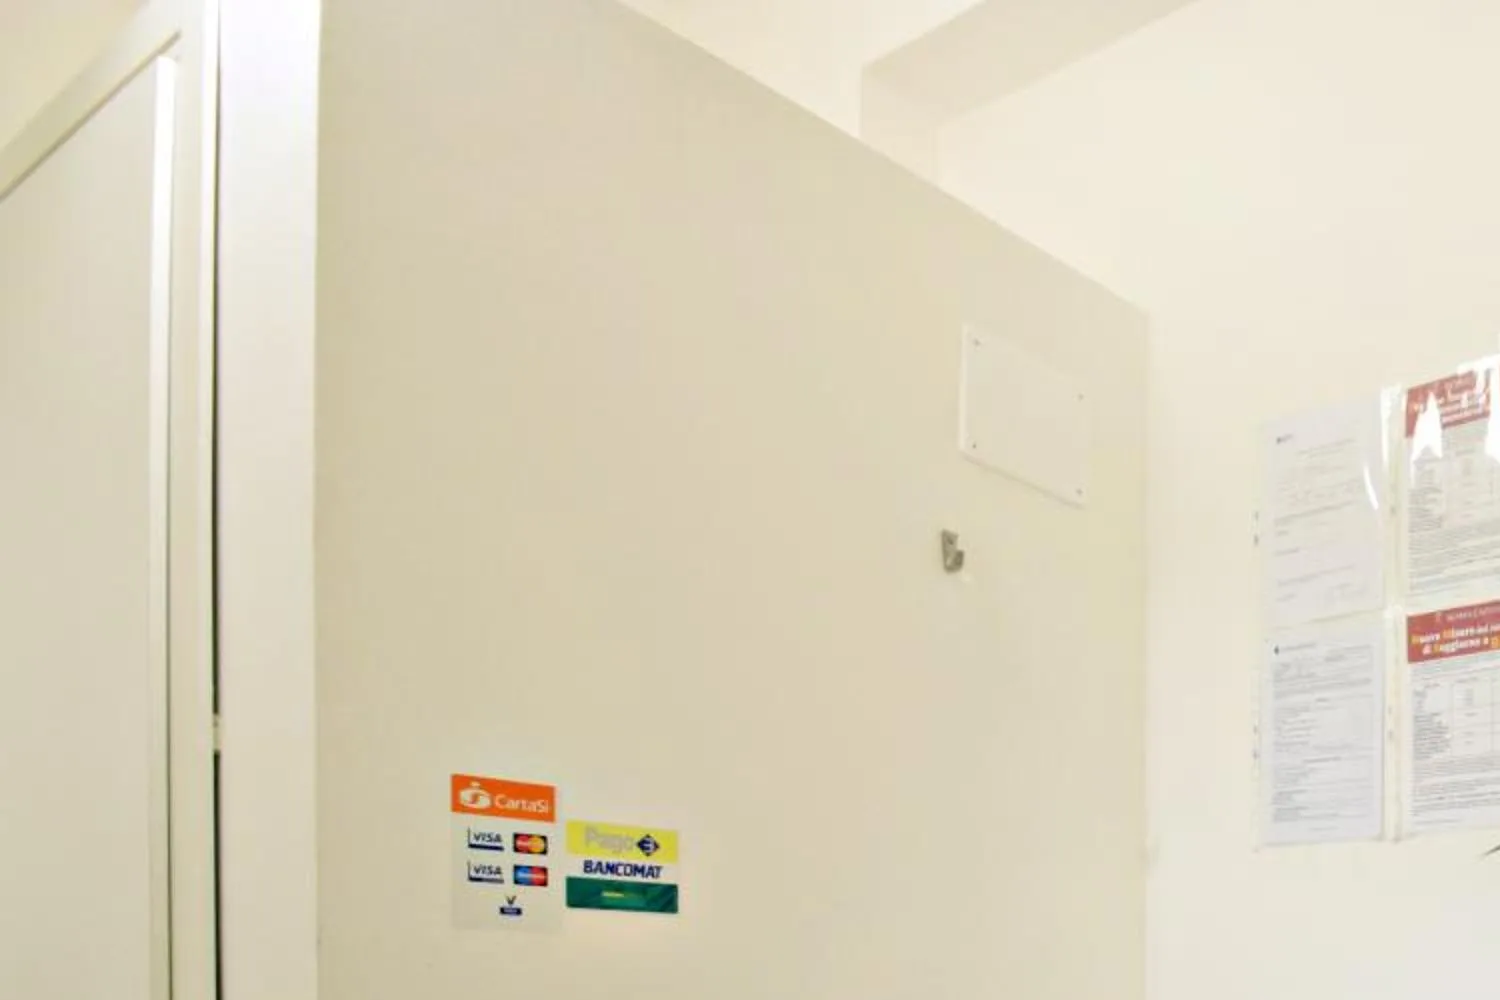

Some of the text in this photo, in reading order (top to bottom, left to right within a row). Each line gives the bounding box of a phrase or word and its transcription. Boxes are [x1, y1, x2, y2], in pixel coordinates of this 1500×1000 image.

[473, 831, 503, 843] VISA
[473, 863, 503, 875] VISA
[583, 859, 664, 880] BANCOMAT
